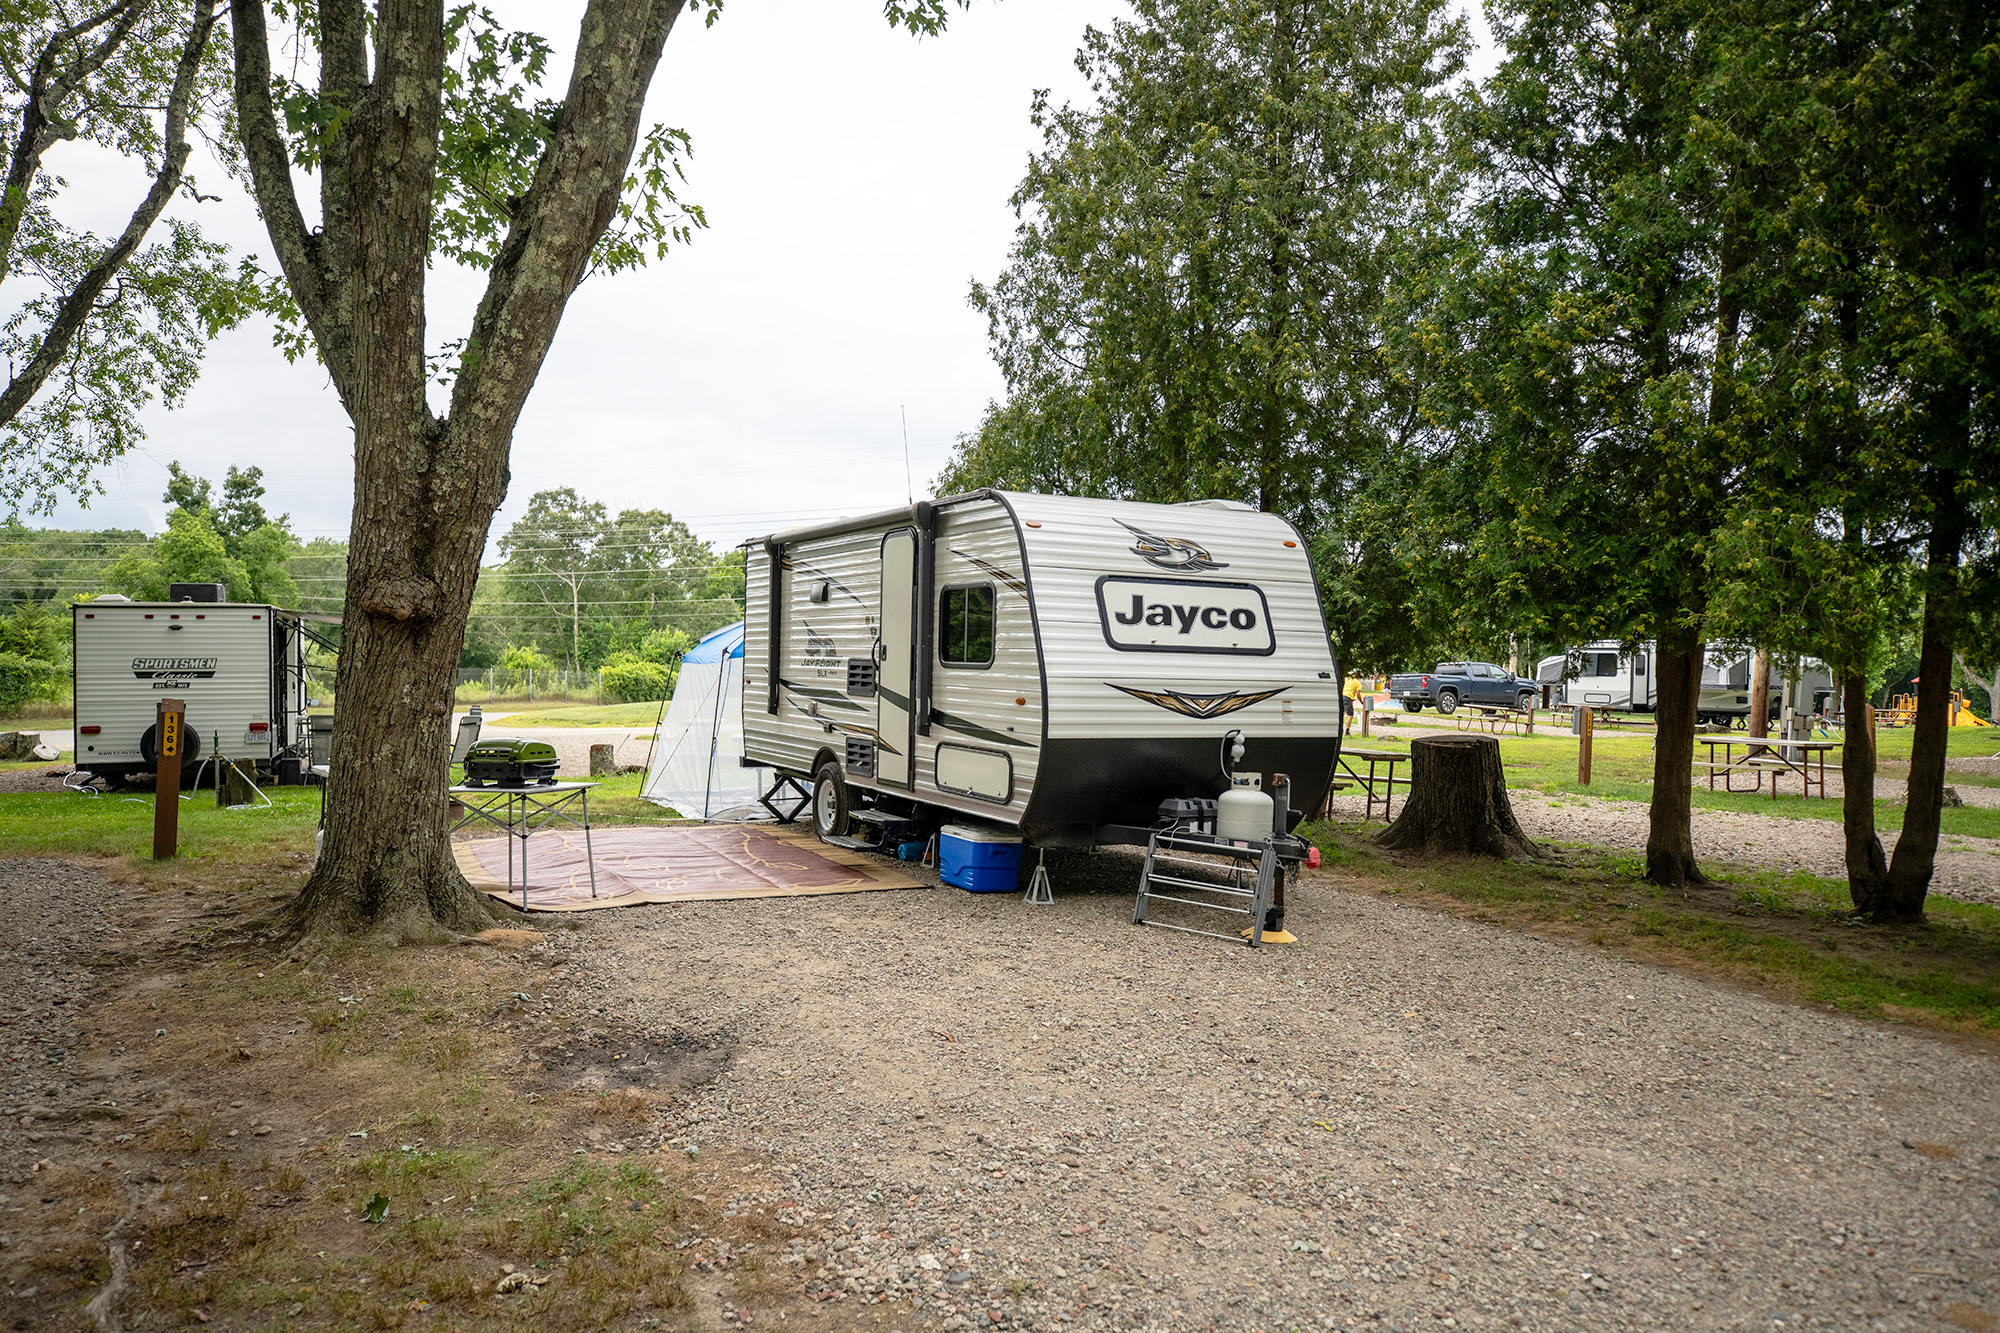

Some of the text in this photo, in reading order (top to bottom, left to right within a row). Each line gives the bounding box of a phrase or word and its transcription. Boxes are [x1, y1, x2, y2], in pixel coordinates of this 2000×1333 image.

[1114, 594, 1257, 635] Jayco
[132, 657, 217, 669] SPORTSMEN
[152, 671, 198, 679] Classic
[816, 669, 828, 677] SLX
[166, 715, 175, 744] 136
